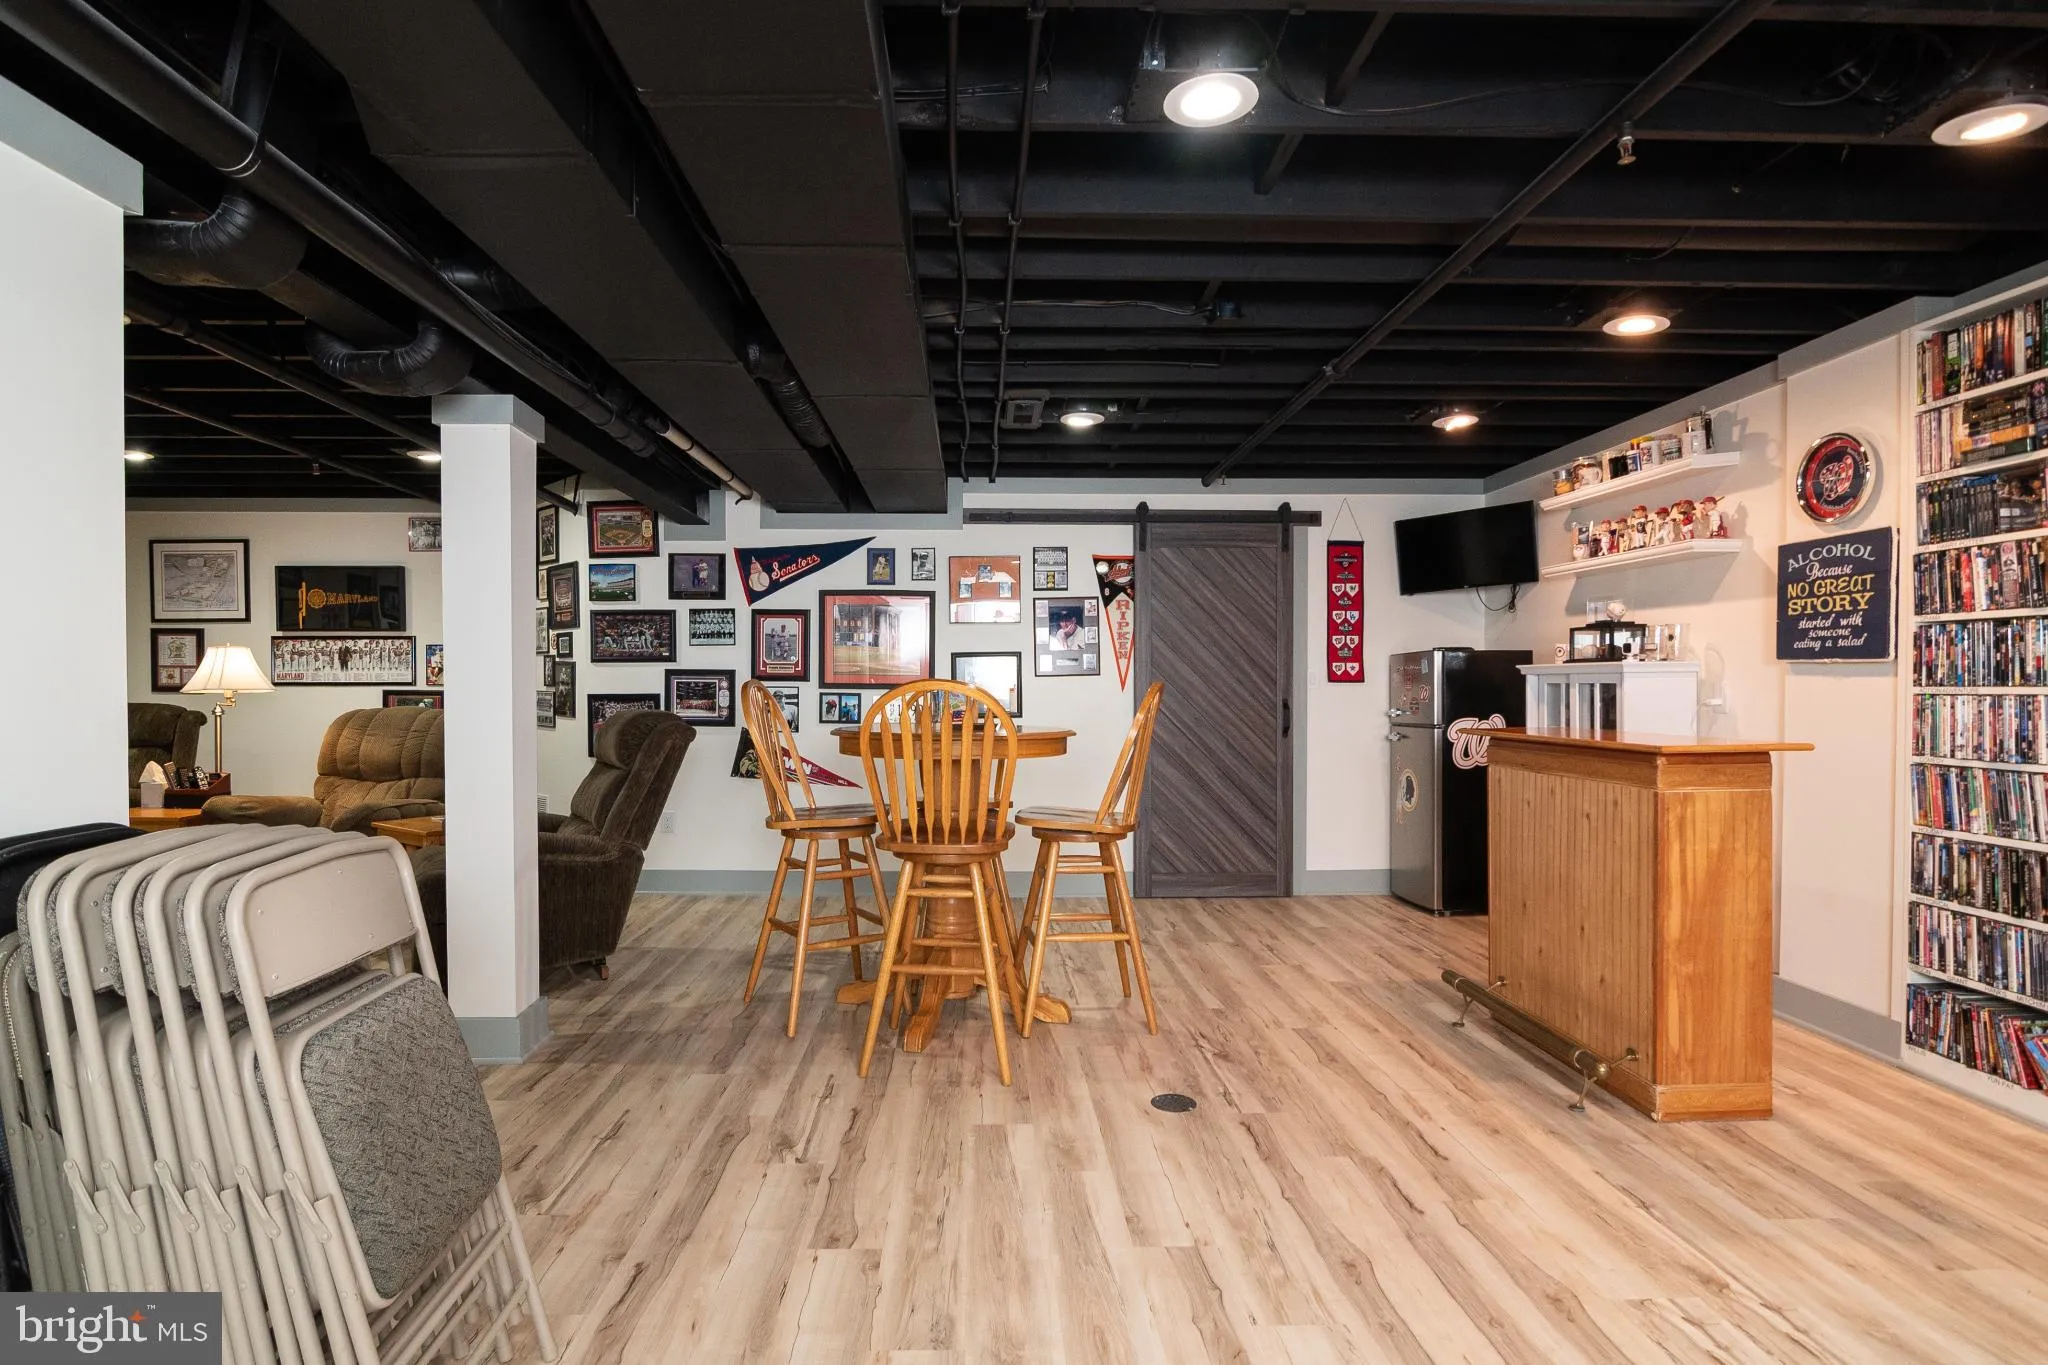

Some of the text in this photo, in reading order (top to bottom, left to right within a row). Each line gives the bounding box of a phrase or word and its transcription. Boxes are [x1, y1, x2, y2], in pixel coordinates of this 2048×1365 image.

[771, 553, 821, 581] Senators
[1787, 543, 1876, 573] ALCOHOL
[1806, 561, 1853, 582] Because
[1787, 574, 1875, 599] NO GREAT
[326, 592, 378, 605] MARYLAND
[1788, 592, 1875, 616] STORY
[1798, 611, 1863, 629] started with
[1793, 633, 1868, 651] eating a salad
[1808, 628, 1851, 638] someone
[277, 672, 305, 680] MARYLAND
